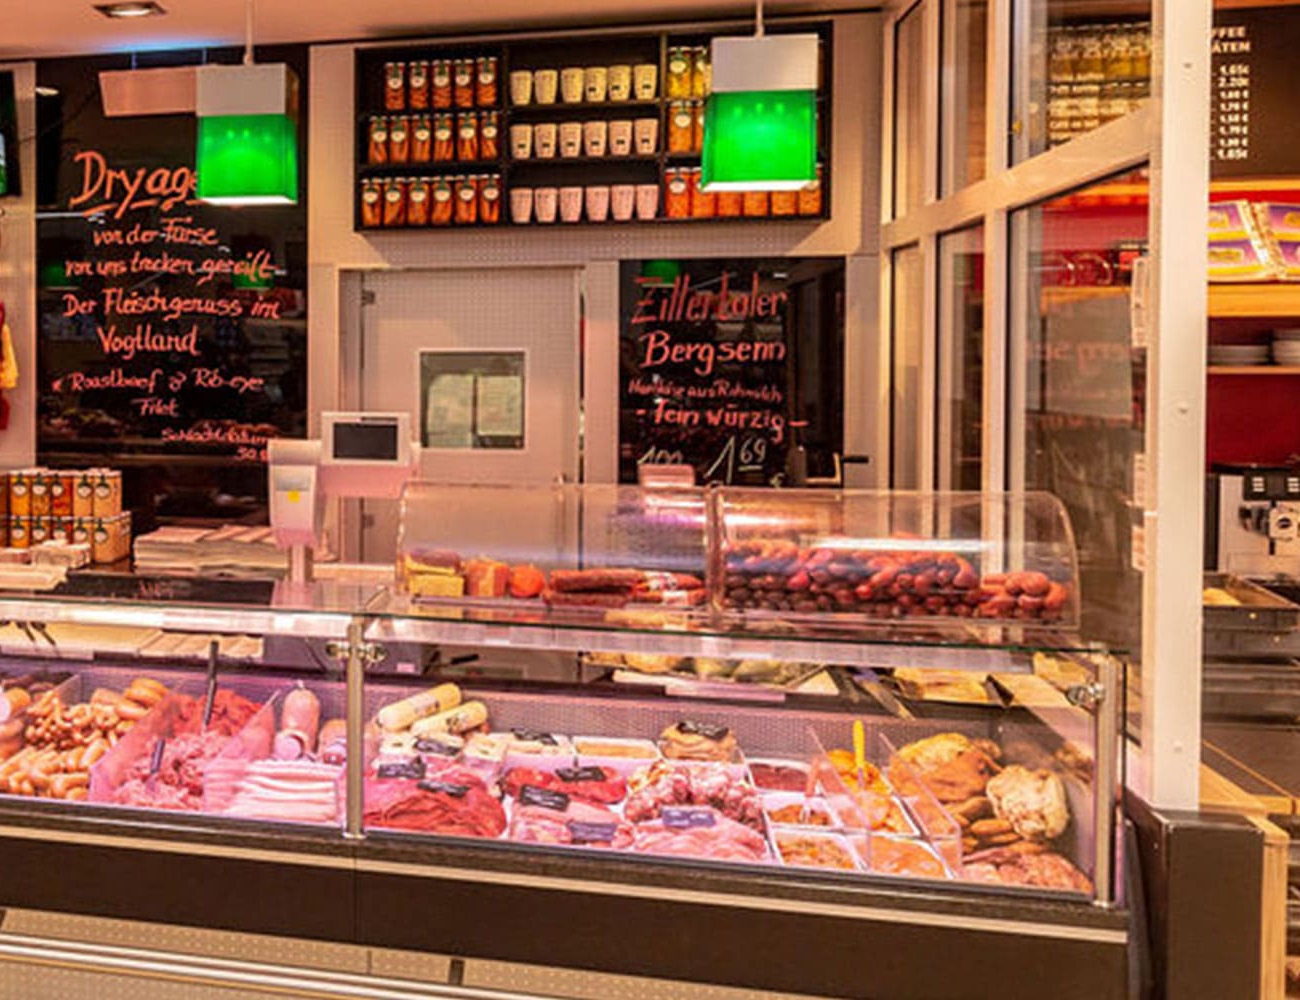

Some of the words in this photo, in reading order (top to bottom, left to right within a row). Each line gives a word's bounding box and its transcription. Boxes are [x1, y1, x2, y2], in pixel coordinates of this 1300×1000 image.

[93, 229, 122, 246] von
[65, 259, 92, 278] von
[96, 260, 127, 276] uns
[62, 293, 96, 317] Der
[102, 287, 243, 321] Fleischgenuss
[251, 295, 280, 319] im
[96, 324, 200, 360] Vogtland
[638, 330, 786, 376] Bergsenn
